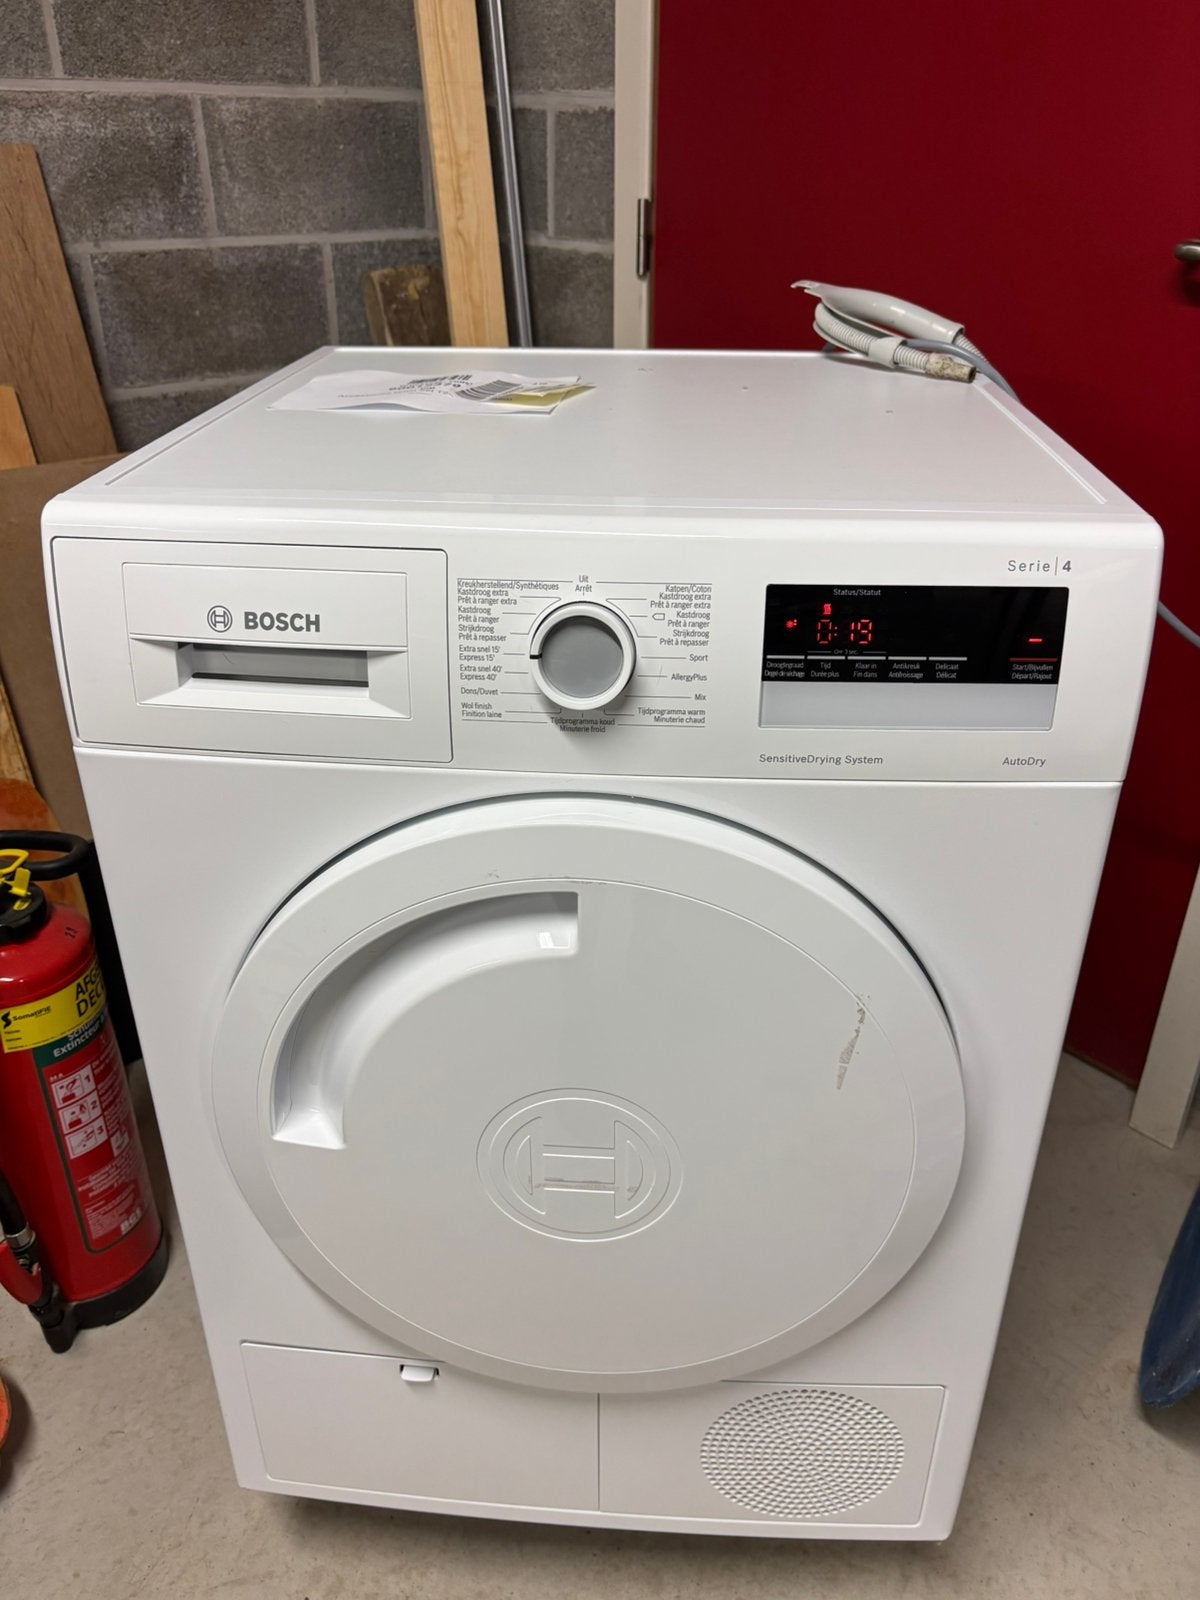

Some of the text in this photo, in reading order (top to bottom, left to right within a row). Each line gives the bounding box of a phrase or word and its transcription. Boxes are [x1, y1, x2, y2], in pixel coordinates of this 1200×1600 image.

[1007, 560, 1072, 573] Serie 4
[578, 574, 589, 583] Uit
[457, 580, 559, 591] Kreukherstellend/Synthétiques
[575, 583, 592, 593] Arrêt
[457, 588, 491, 597] Kastdroog
[659, 593, 711, 601] Kastdroog extra
[833, 587, 882, 597] Status/Statut
[457, 595, 471, 604] Prêt
[477, 598, 499, 606] ranger
[500, 598, 517, 606] extra
[650, 600, 664, 609] Prêt
[671, 602, 693, 610] ranger
[693, 601, 711, 609] extra
[457, 606, 492, 616] Kastdroog
[676, 611, 711, 620] Kastdroog
[243, 611, 321, 633] BOSCH
[458, 614, 472, 623] Prêt
[478, 616, 500, 625] ranger
[667, 619, 681, 628] Prêt
[458, 624, 495, 635] Strijkdroog
[672, 629, 710, 639] Strijkdroog
[817, 618, 873, 645] 0:19
[458, 633, 473, 642] Prêt
[479, 635, 507, 644] repasser
[659, 638, 674, 647] Prêt
[680, 639, 709, 648] repasser
[459, 645, 477, 654] Extra
[477, 646, 491, 654] snel
[459, 653, 485, 662] Express
[689, 653, 709, 663] Sport
[460, 664, 477, 673] Extra
[478, 665, 492, 673] snel
[820, 661, 832, 671] Tijd
[854, 662, 878, 670] Klaar in
[892, 662, 921, 670] Antikreuk
[935, 663, 959, 671] Delicaat
[460, 673, 486, 682] Express
[671, 673, 708, 683] AllergyPlus
[810, 669, 840, 680] Durée plus
[852, 671, 878, 679] Fin dans
[936, 671, 958, 680] Délicat
[1011, 672, 1053, 681] Départ/Rajout
[460, 687, 499, 696] Dons/Duvet
[695, 693, 707, 701] Mix
[461, 702, 493, 710] Wol finish
[461, 710, 503, 720] Finition laine
[637, 706, 706, 717] Tijdprogramma warm
[550, 716, 616, 727] Tijdprogramma koud
[653, 714, 706, 725] Minuterie chaud
[559, 725, 607, 735] Minuterie froid
[758, 753, 884, 766] SensitiveDrying System
[1002, 755, 1047, 768] AutoDry
[90, 1100, 98, 1110] 2
